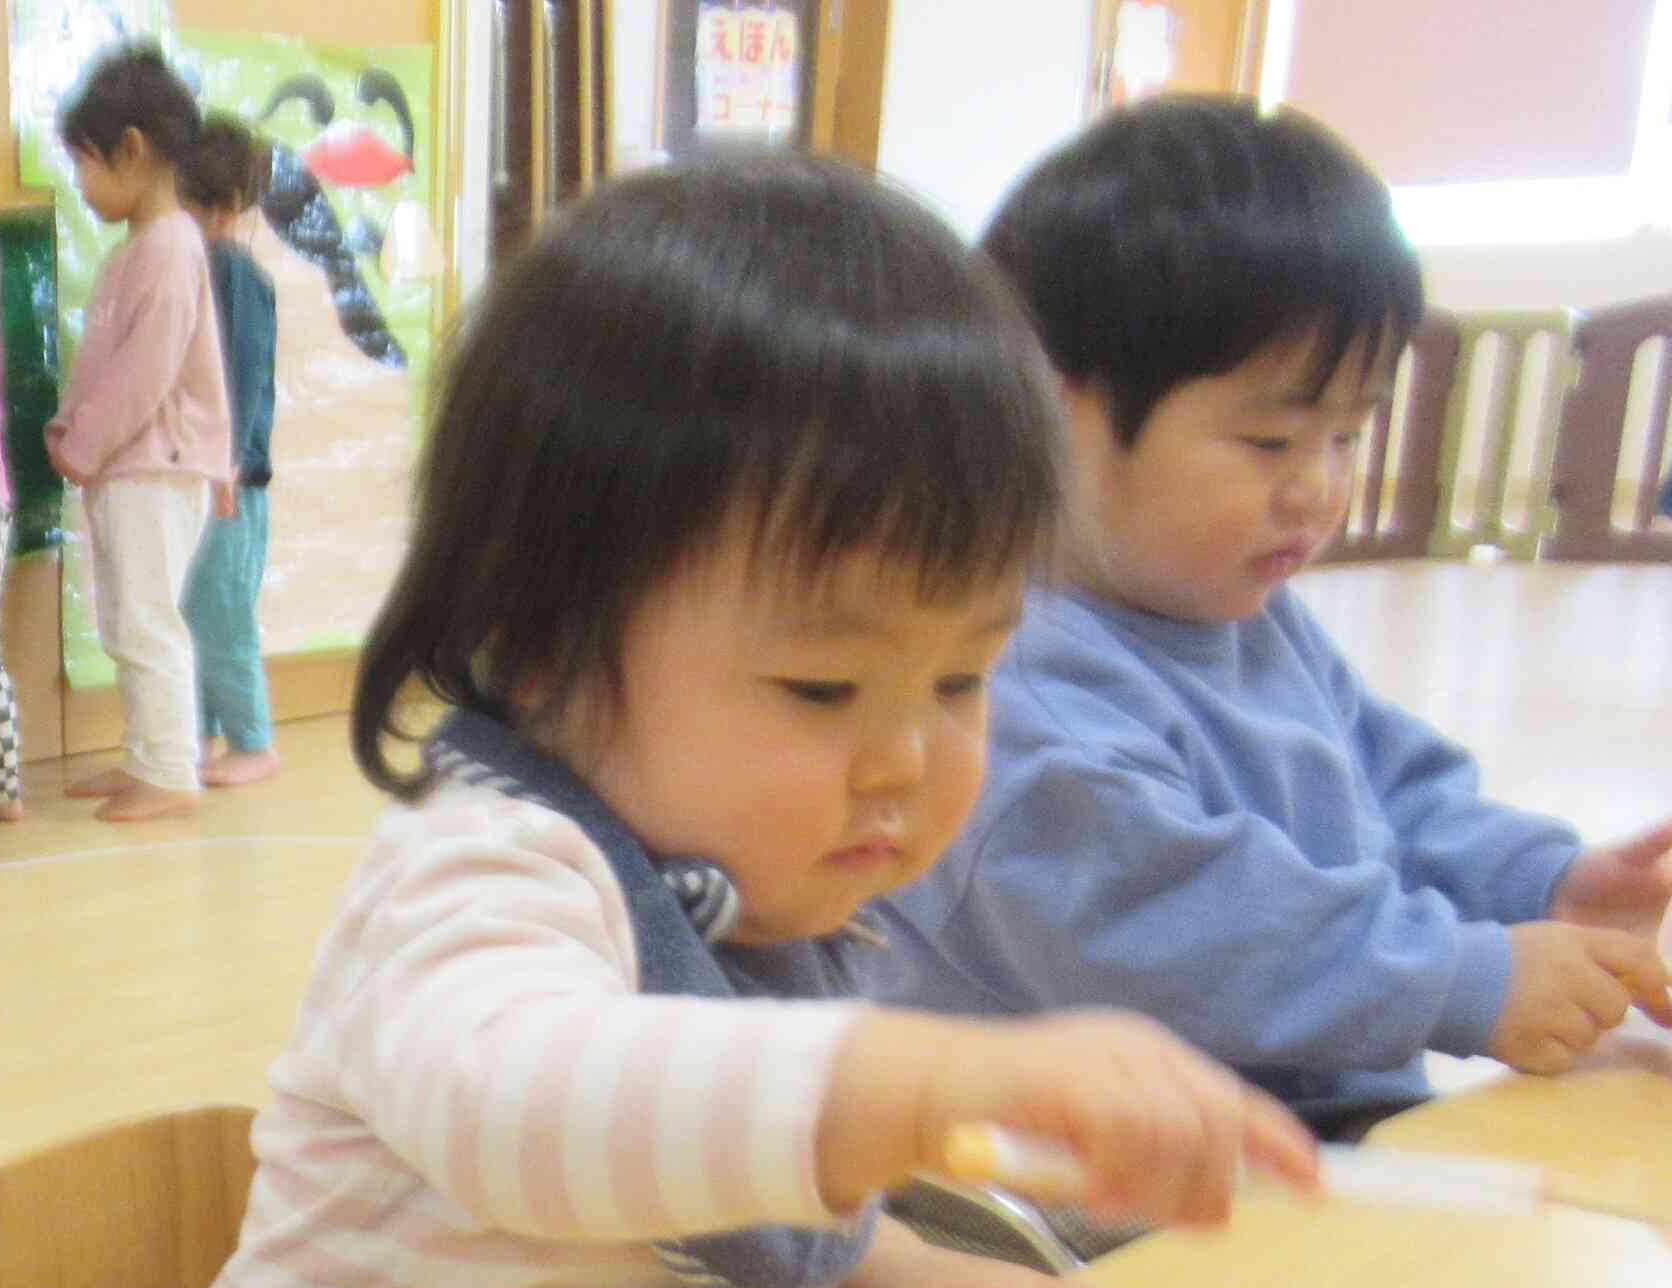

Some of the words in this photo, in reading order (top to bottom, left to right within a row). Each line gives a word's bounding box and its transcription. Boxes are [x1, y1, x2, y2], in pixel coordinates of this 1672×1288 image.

[710, 16, 793, 63] えほん
[711, 92, 793, 121] コーナー
